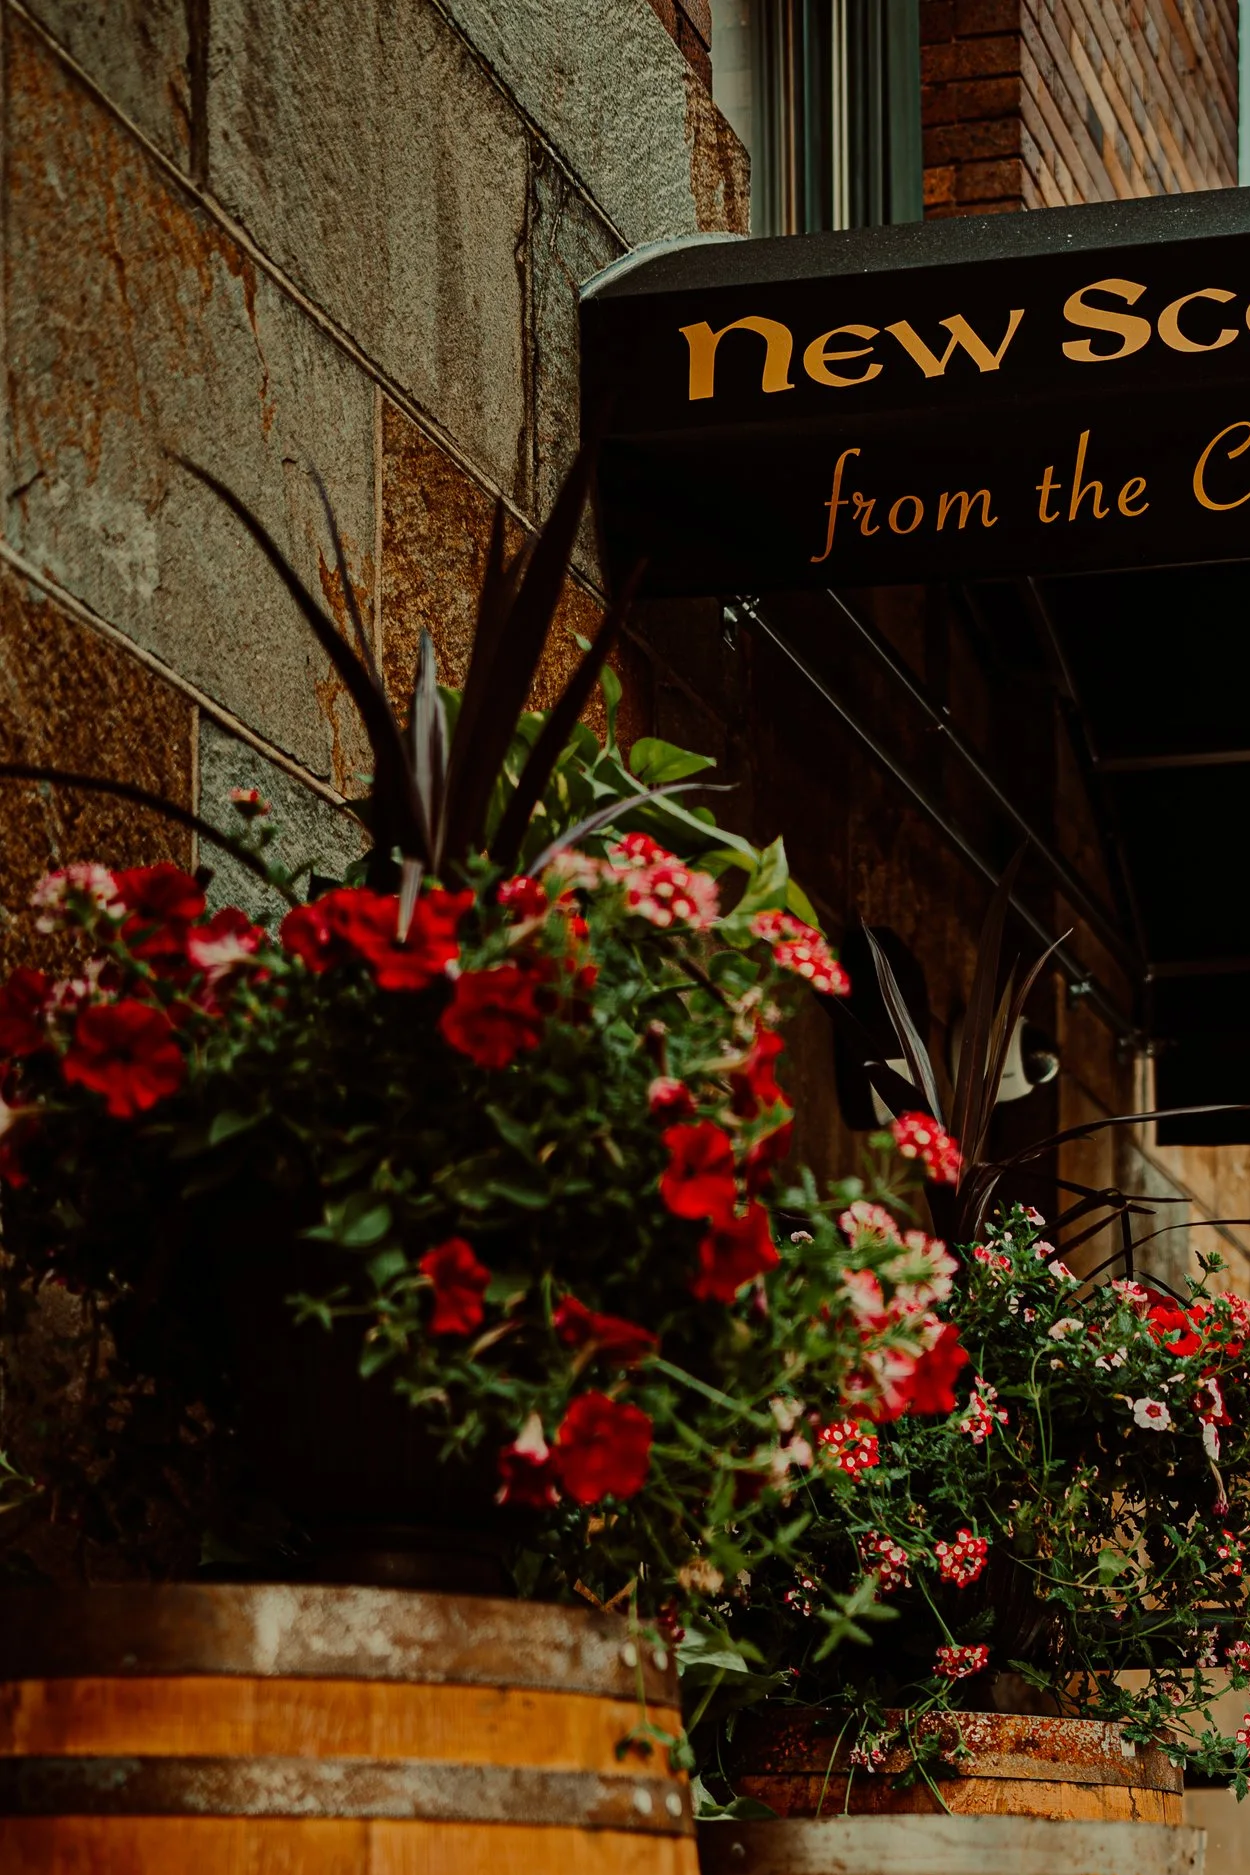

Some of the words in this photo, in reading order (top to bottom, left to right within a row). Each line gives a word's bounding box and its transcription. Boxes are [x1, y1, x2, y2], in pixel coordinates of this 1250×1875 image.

[678, 308, 1026, 401] New
[810, 447, 999, 563] from
[1035, 429, 1150, 524] the
